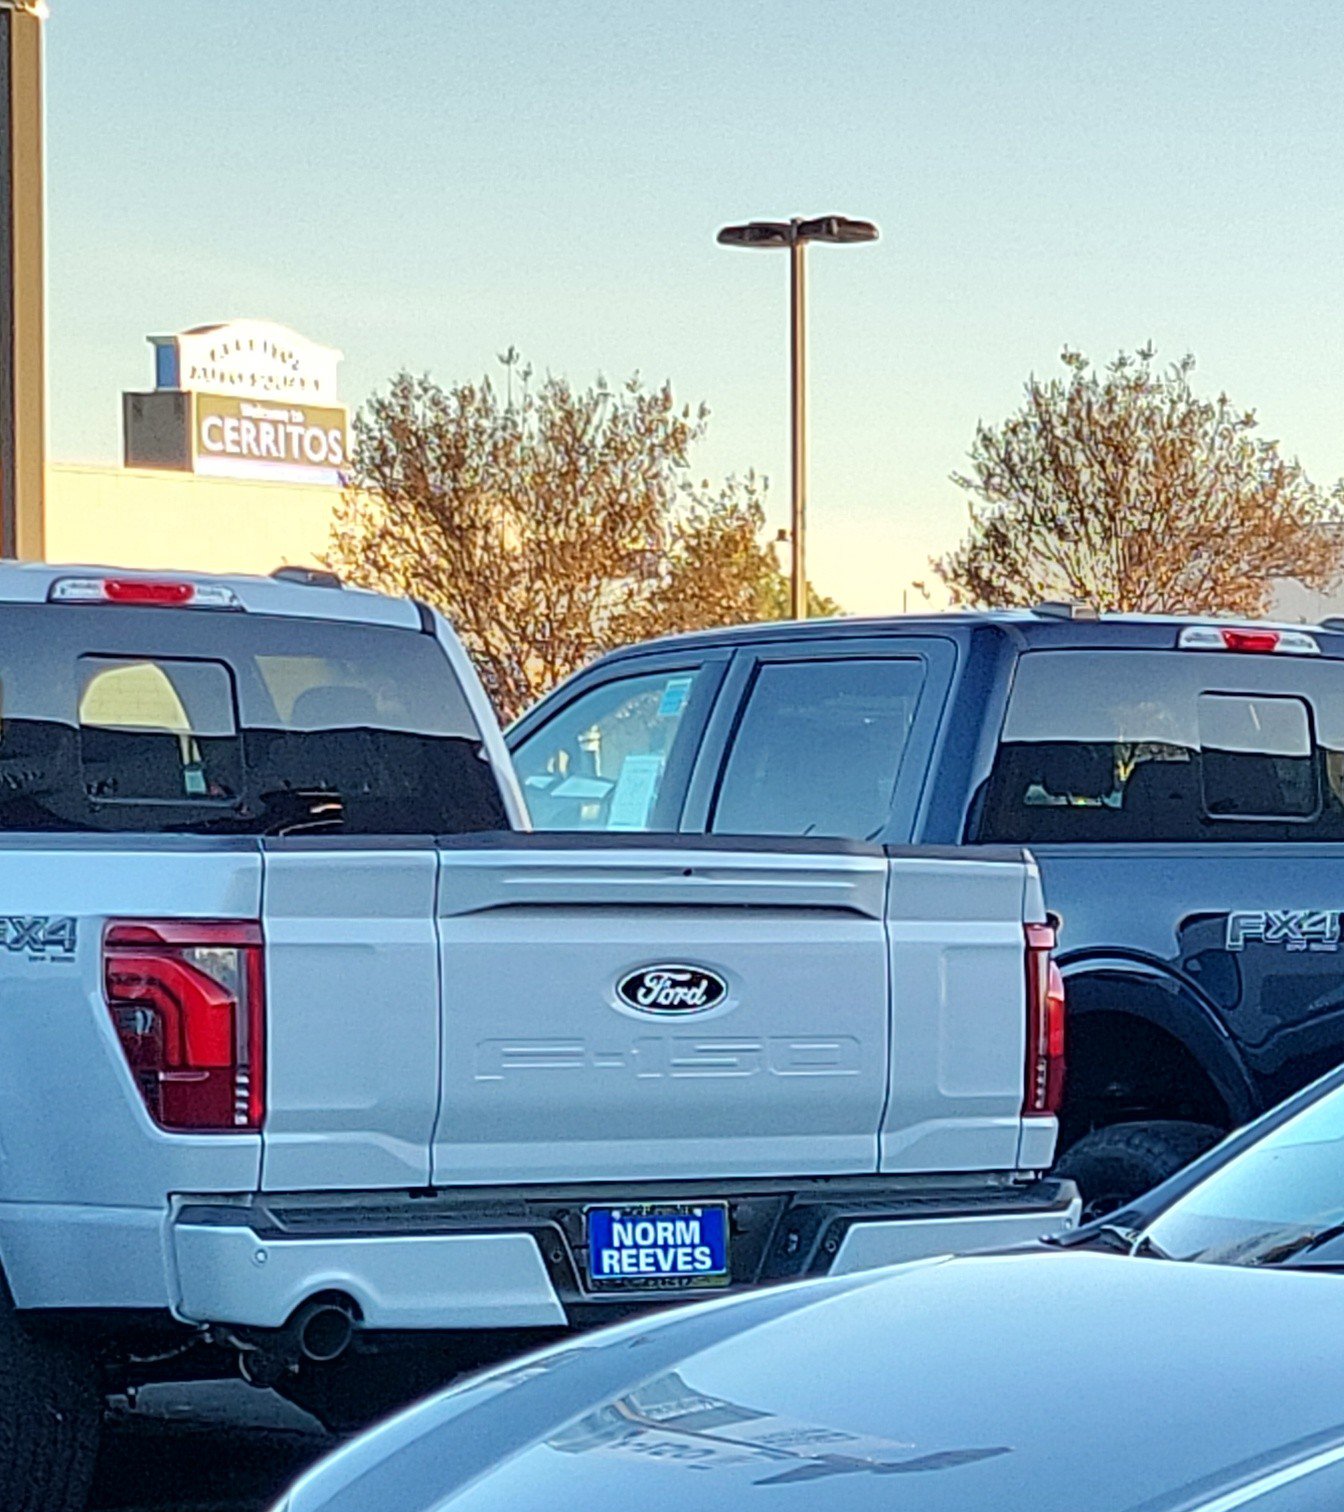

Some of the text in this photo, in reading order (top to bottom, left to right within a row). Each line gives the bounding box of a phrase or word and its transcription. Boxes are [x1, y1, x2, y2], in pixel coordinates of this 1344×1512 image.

[201, 415, 343, 465] CERRITOS
[1225, 910, 1340, 952] FX4
[637, 972, 709, 1006] Ford
[474, 1035, 862, 1080] F-150
[612, 1220, 700, 1248] NORM
[602, 1246, 713, 1274] REEVES
